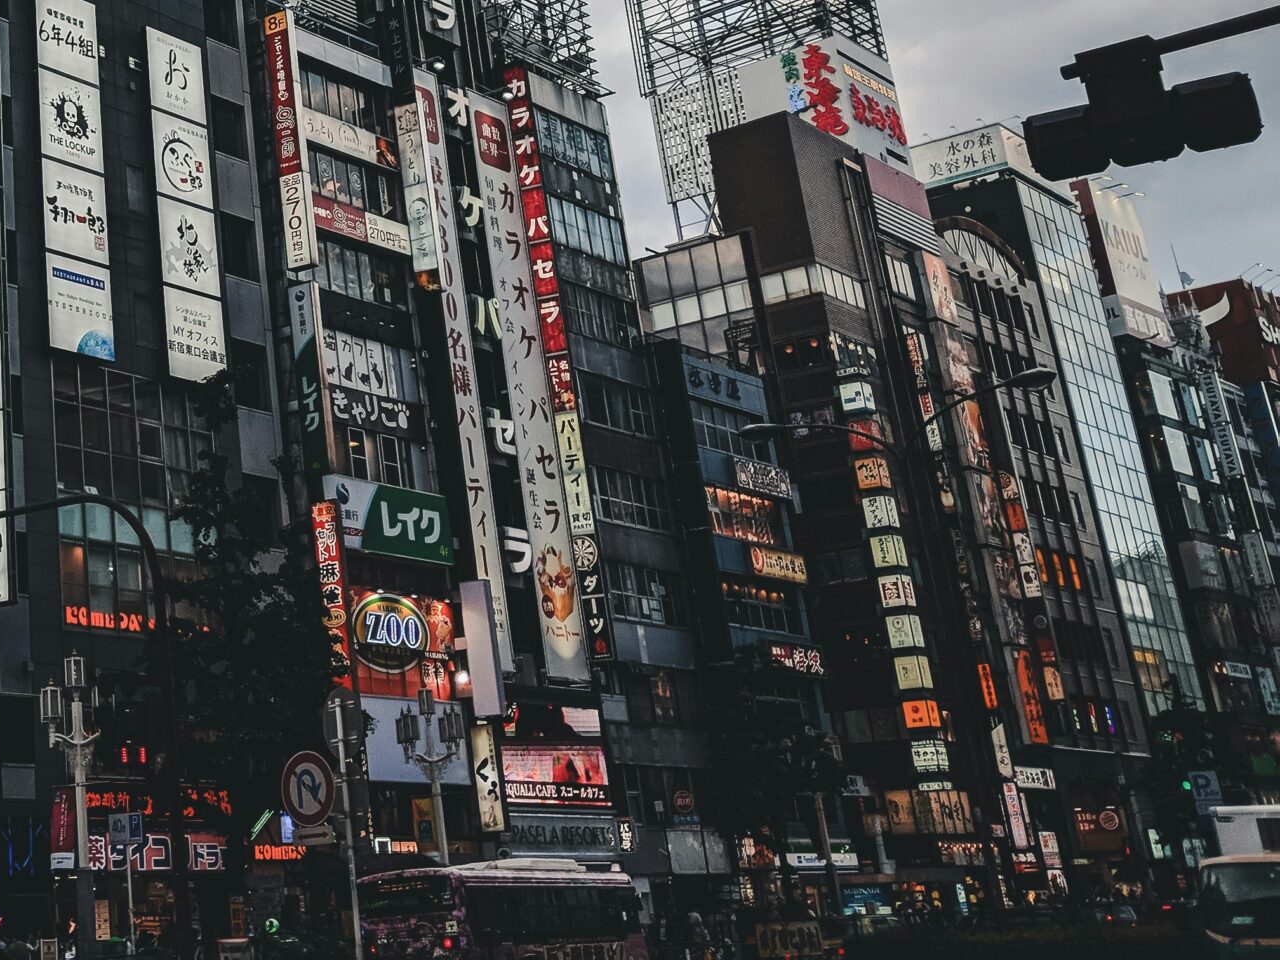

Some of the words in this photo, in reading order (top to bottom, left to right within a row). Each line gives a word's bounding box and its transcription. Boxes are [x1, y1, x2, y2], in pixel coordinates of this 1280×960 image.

[39, 20, 96, 59] 6年4組
[268, 17, 284, 30] 8F
[49, 133, 64, 146] THE
[945, 133, 993, 157] 水の森
[929, 150, 997, 178] 美容外科
[302, 376, 320, 432] レイク
[1203, 375, 1222, 420] TSUTAYA
[1218, 426, 1237, 473] TSUTAYA
[380, 501, 441, 544] レイク
[366, 611, 422, 649] ZOO
[511, 826, 560, 846] PASELA
